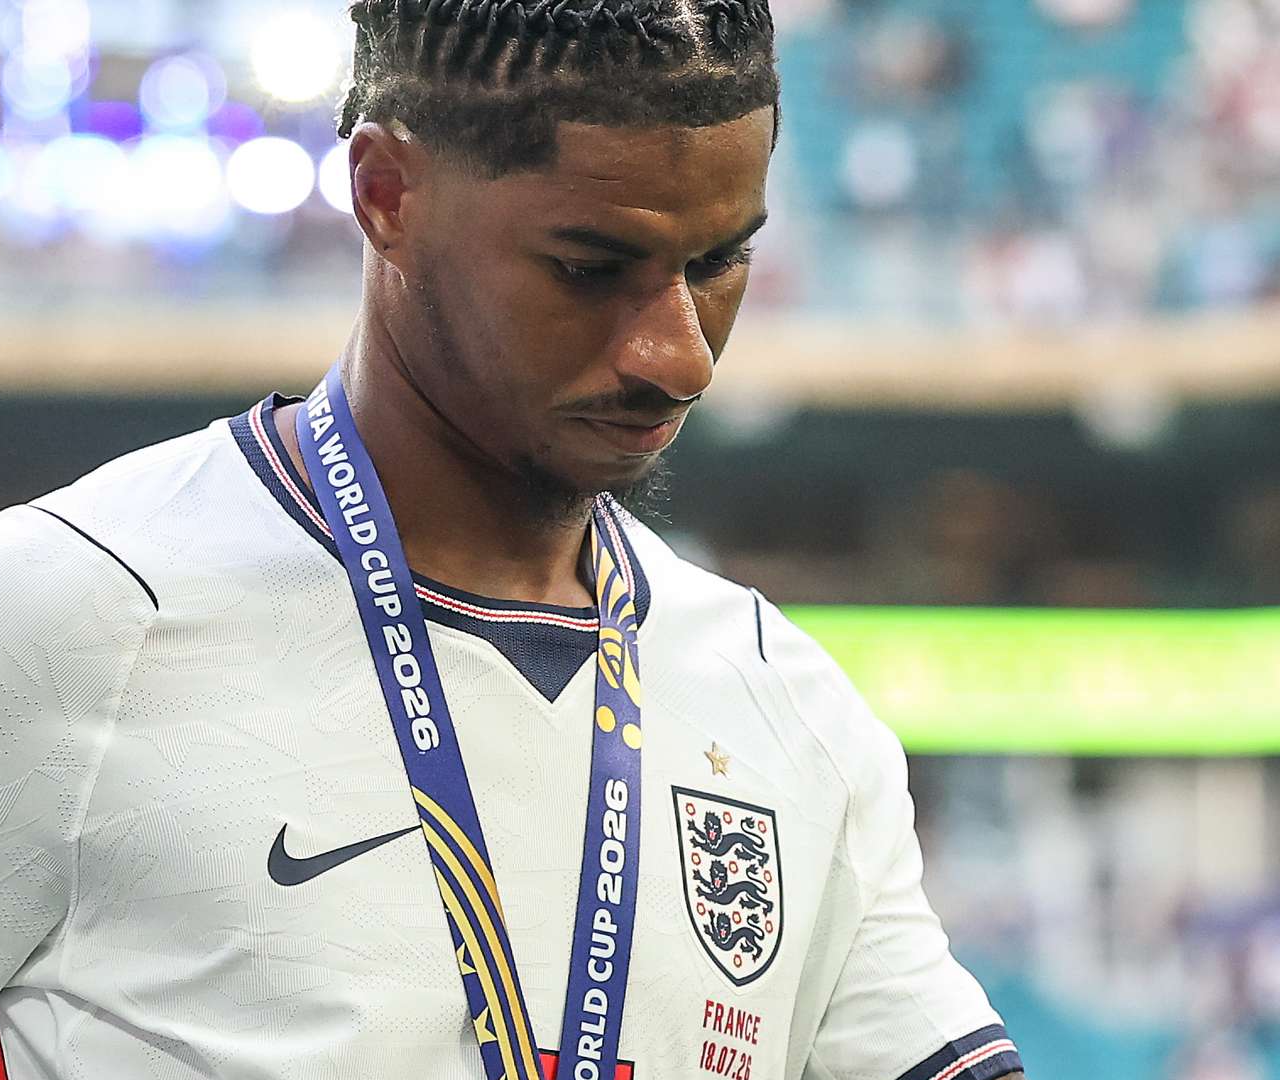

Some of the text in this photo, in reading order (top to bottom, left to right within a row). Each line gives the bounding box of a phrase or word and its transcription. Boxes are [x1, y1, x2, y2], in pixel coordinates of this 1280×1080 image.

[318, 432, 378, 546] WORLD
[361, 549, 403, 618] CUP
[382, 623, 441, 752] 2026
[596, 778, 629, 905] 2026
[587, 908, 619, 983] CUP
[702, 999, 761, 1046] FRANCE
